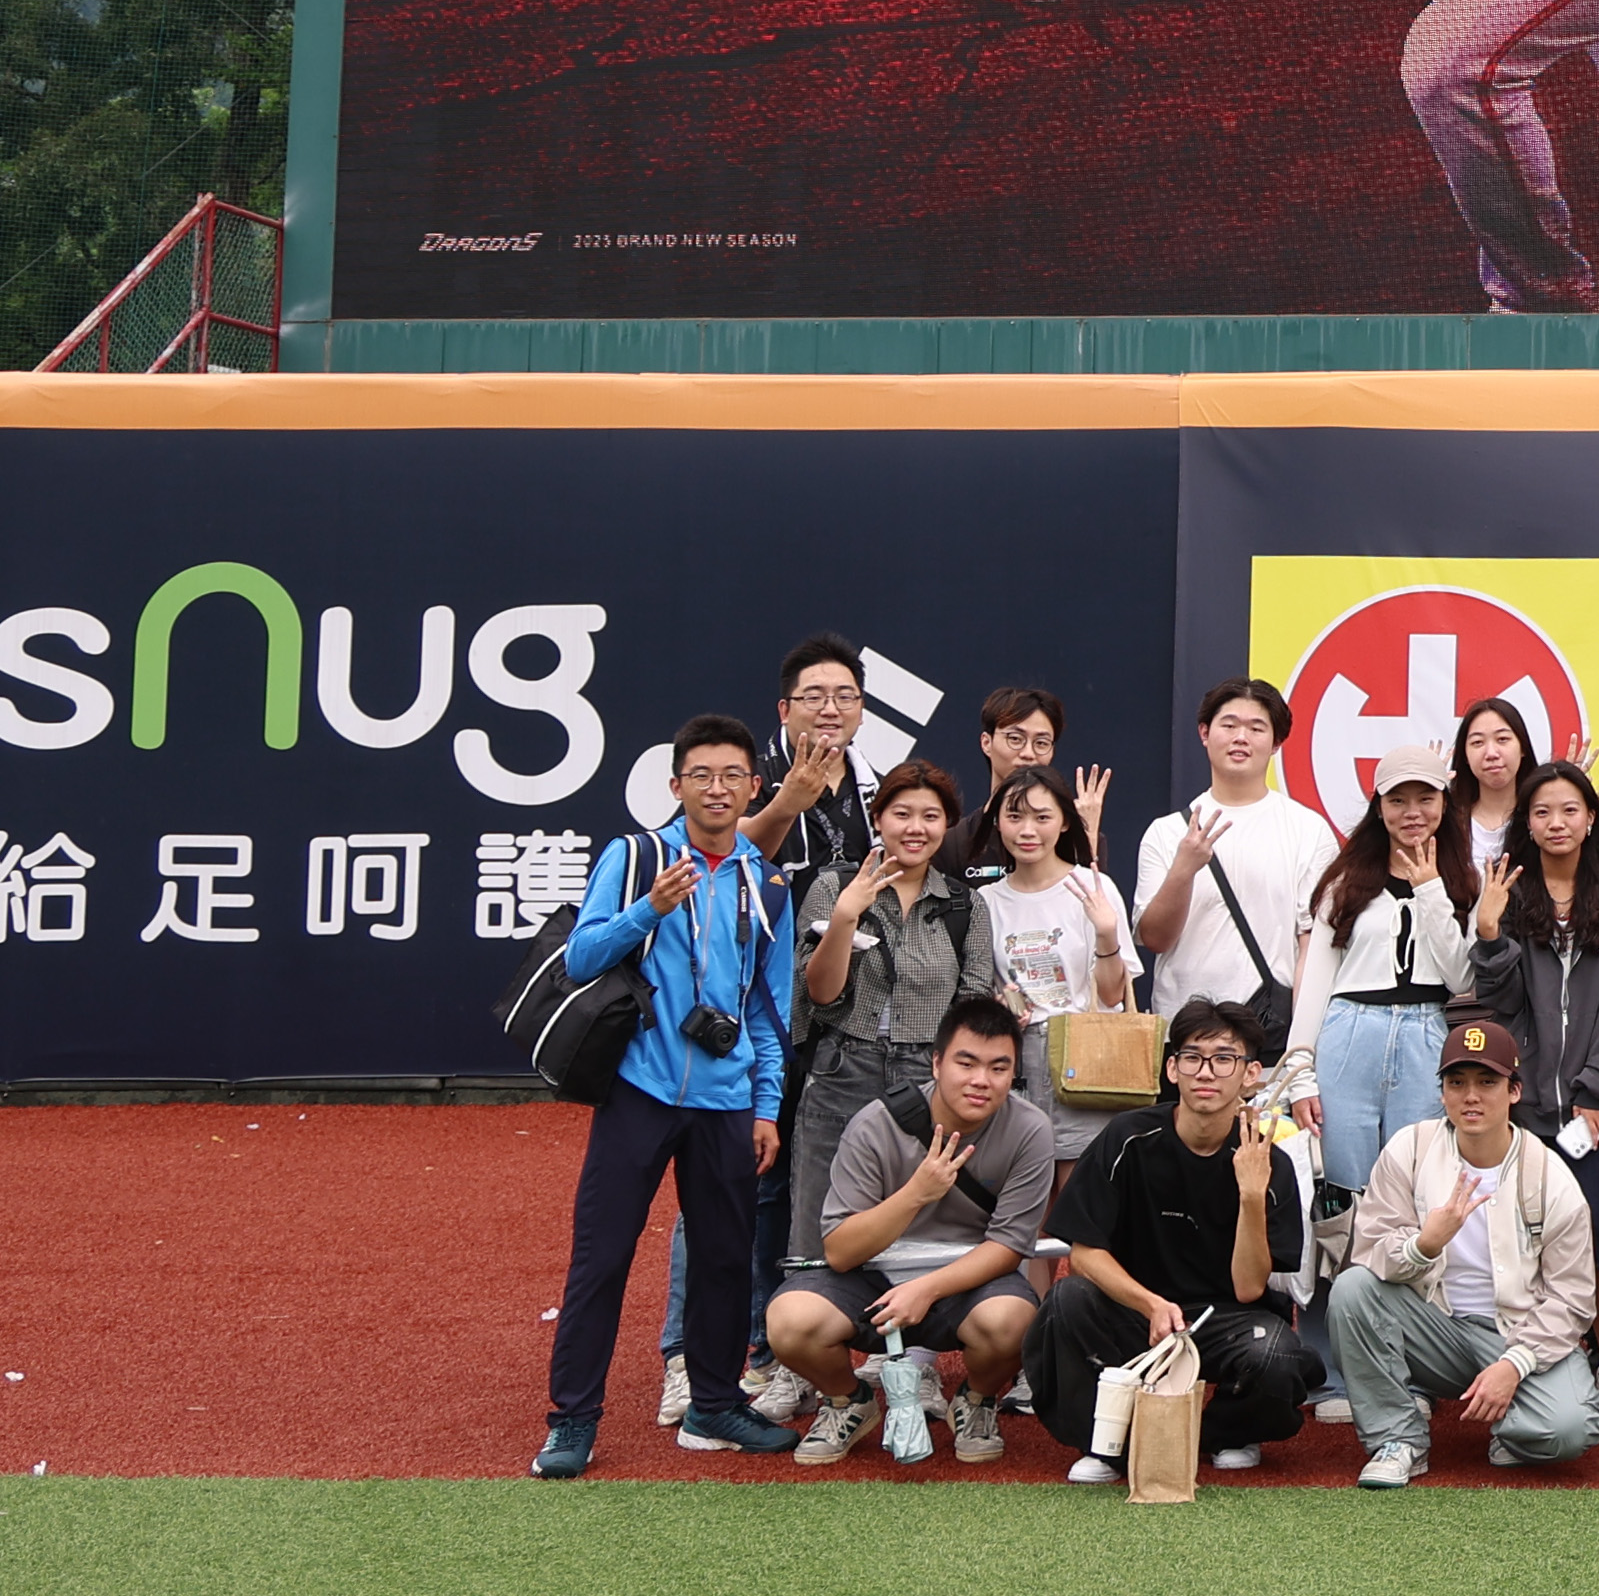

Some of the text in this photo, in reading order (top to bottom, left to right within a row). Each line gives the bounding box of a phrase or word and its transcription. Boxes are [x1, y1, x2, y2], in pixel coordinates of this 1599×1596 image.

[419, 231, 543, 253] DRAGONS
[616, 233, 678, 248] BRAND
[681, 233, 723, 248] NEW
[727, 232, 799, 248] SEASON
[0, 562, 606, 805] snug
[0, 830, 592, 941] 給足呵護
